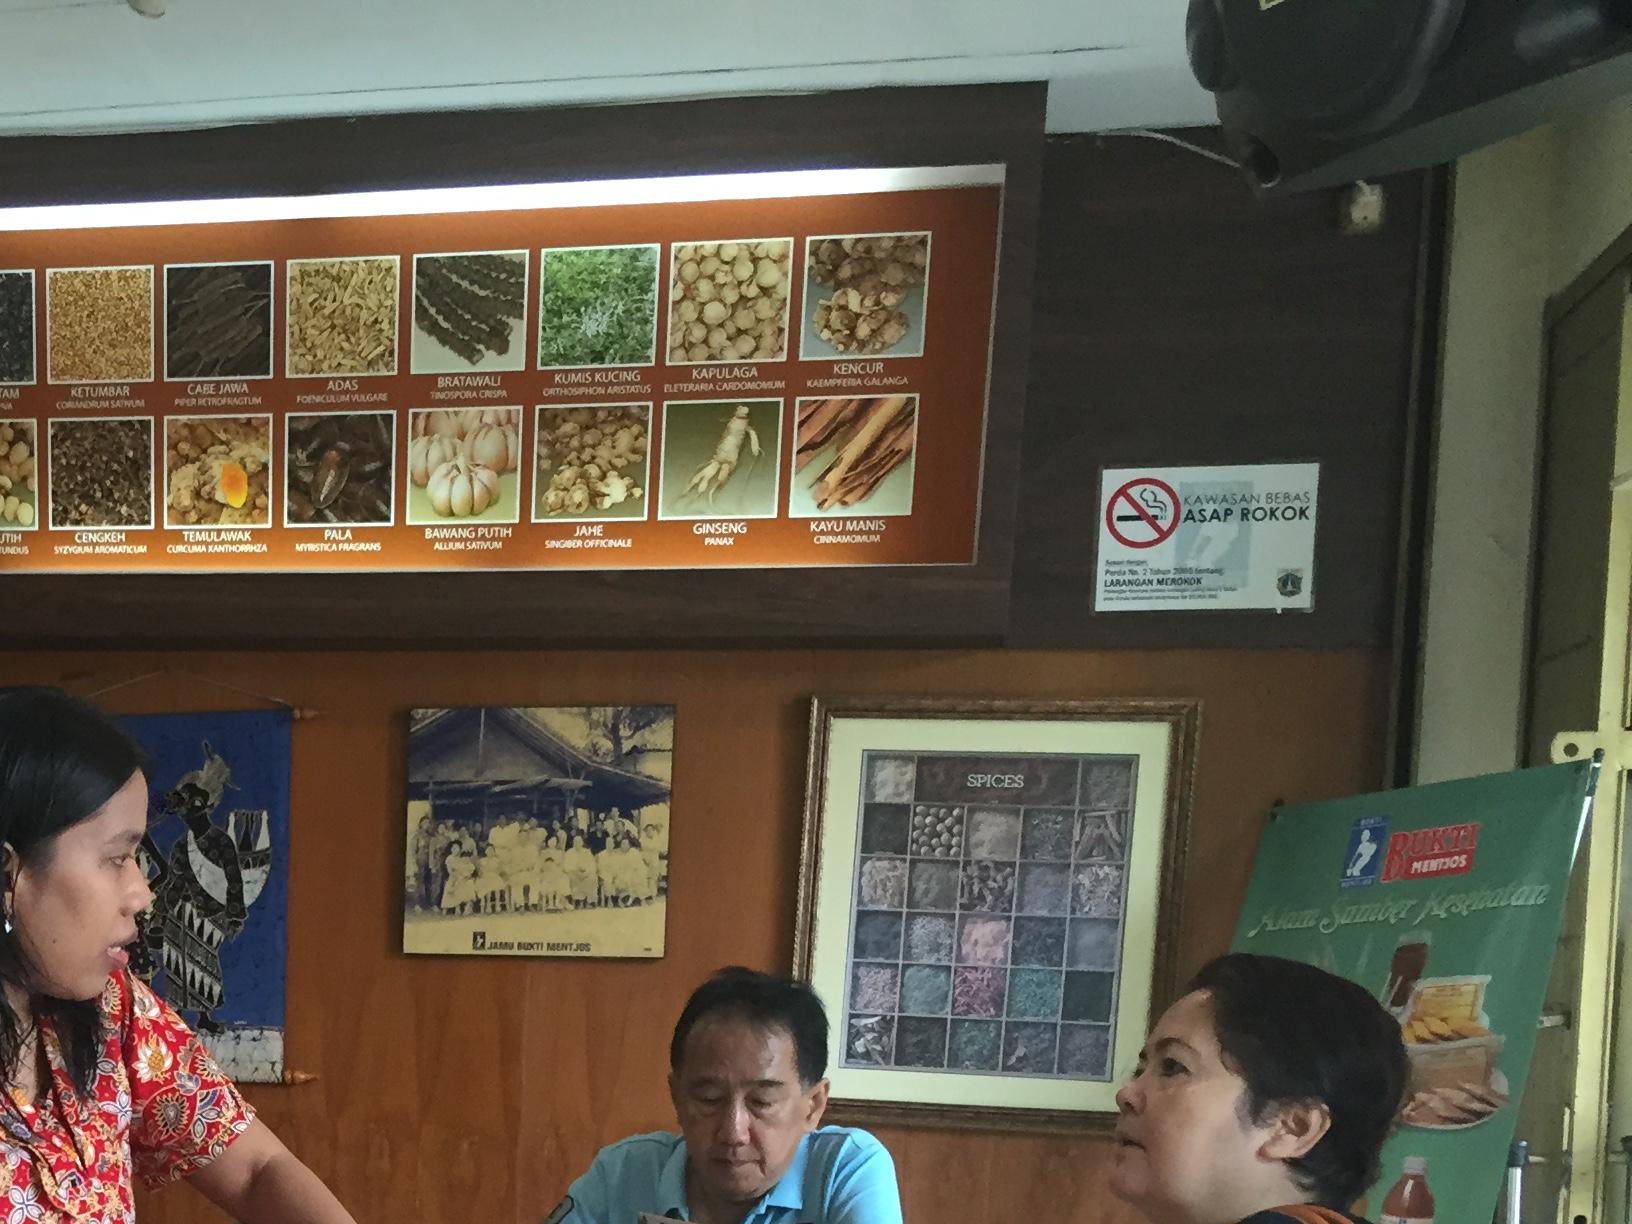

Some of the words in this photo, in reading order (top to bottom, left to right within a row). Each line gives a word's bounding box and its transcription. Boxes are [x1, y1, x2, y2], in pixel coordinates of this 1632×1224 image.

[692, 367, 758, 379] KAPULAGA
[833, 363, 884, 375] KENCUR
[437, 376, 501, 387] BRATAWALI
[554, 373, 591, 384] KUMIS
[595, 371, 641, 383] KUCING
[864, 377, 908, 386] GALANGA
[187, 384, 216, 395] CABE
[219, 383, 249, 394] JAWA
[327, 380, 358, 391] ADAS
[543, 386, 605, 396] ORTHOSIPHON
[607, 384, 651, 394] ARISTATUS
[71, 386, 129, 397] KETUMBAR
[431, 391, 477, 399] TINOSPORA
[479, 390, 507, 398] CRISPA
[351, 393, 388, 402] VULGARE
[1184, 494, 1261, 506] KAWASAN
[1266, 492, 1310, 504] BEBAS
[1183, 509, 1233, 523] ASAP
[1241, 506, 1310, 521] ROKOK
[574, 525, 603, 536] JAHE
[693, 523, 747, 534] GINSENG
[810, 522, 842, 532] KAYU
[846, 520, 886, 532] MANIS
[75, 533, 125, 542] CENGKEH
[183, 531, 251, 542] TEMULAWAK
[324, 530, 352, 540] PALA
[425, 528, 475, 539] BAWANG
[478, 527, 512, 537] PUTIH
[584, 539, 632, 548] OFFICINALE
[704, 537, 734, 546] PANAX
[814, 534, 880, 544] CINNAMOMUM
[54, 546, 93, 555] SYZYGIUM
[94, 545, 147, 554] AROMATICUM
[167, 544, 206, 553] CURCUMA
[338, 542, 381, 551] FRAGRANS
[434, 541, 464, 550] ALLIUM
[466, 541, 502, 550] SATIVUM
[1104, 578, 1153, 587] LARANGAN
[1156, 576, 1202, 586] MEROKOK
[967, 774, 1024, 788] SPICES
[1380, 822, 1479, 883] BUKTI
[487, 942, 514, 950] JAMU
[517, 942, 543, 951] BUKTI
[547, 943, 591, 952] MENTJOS
